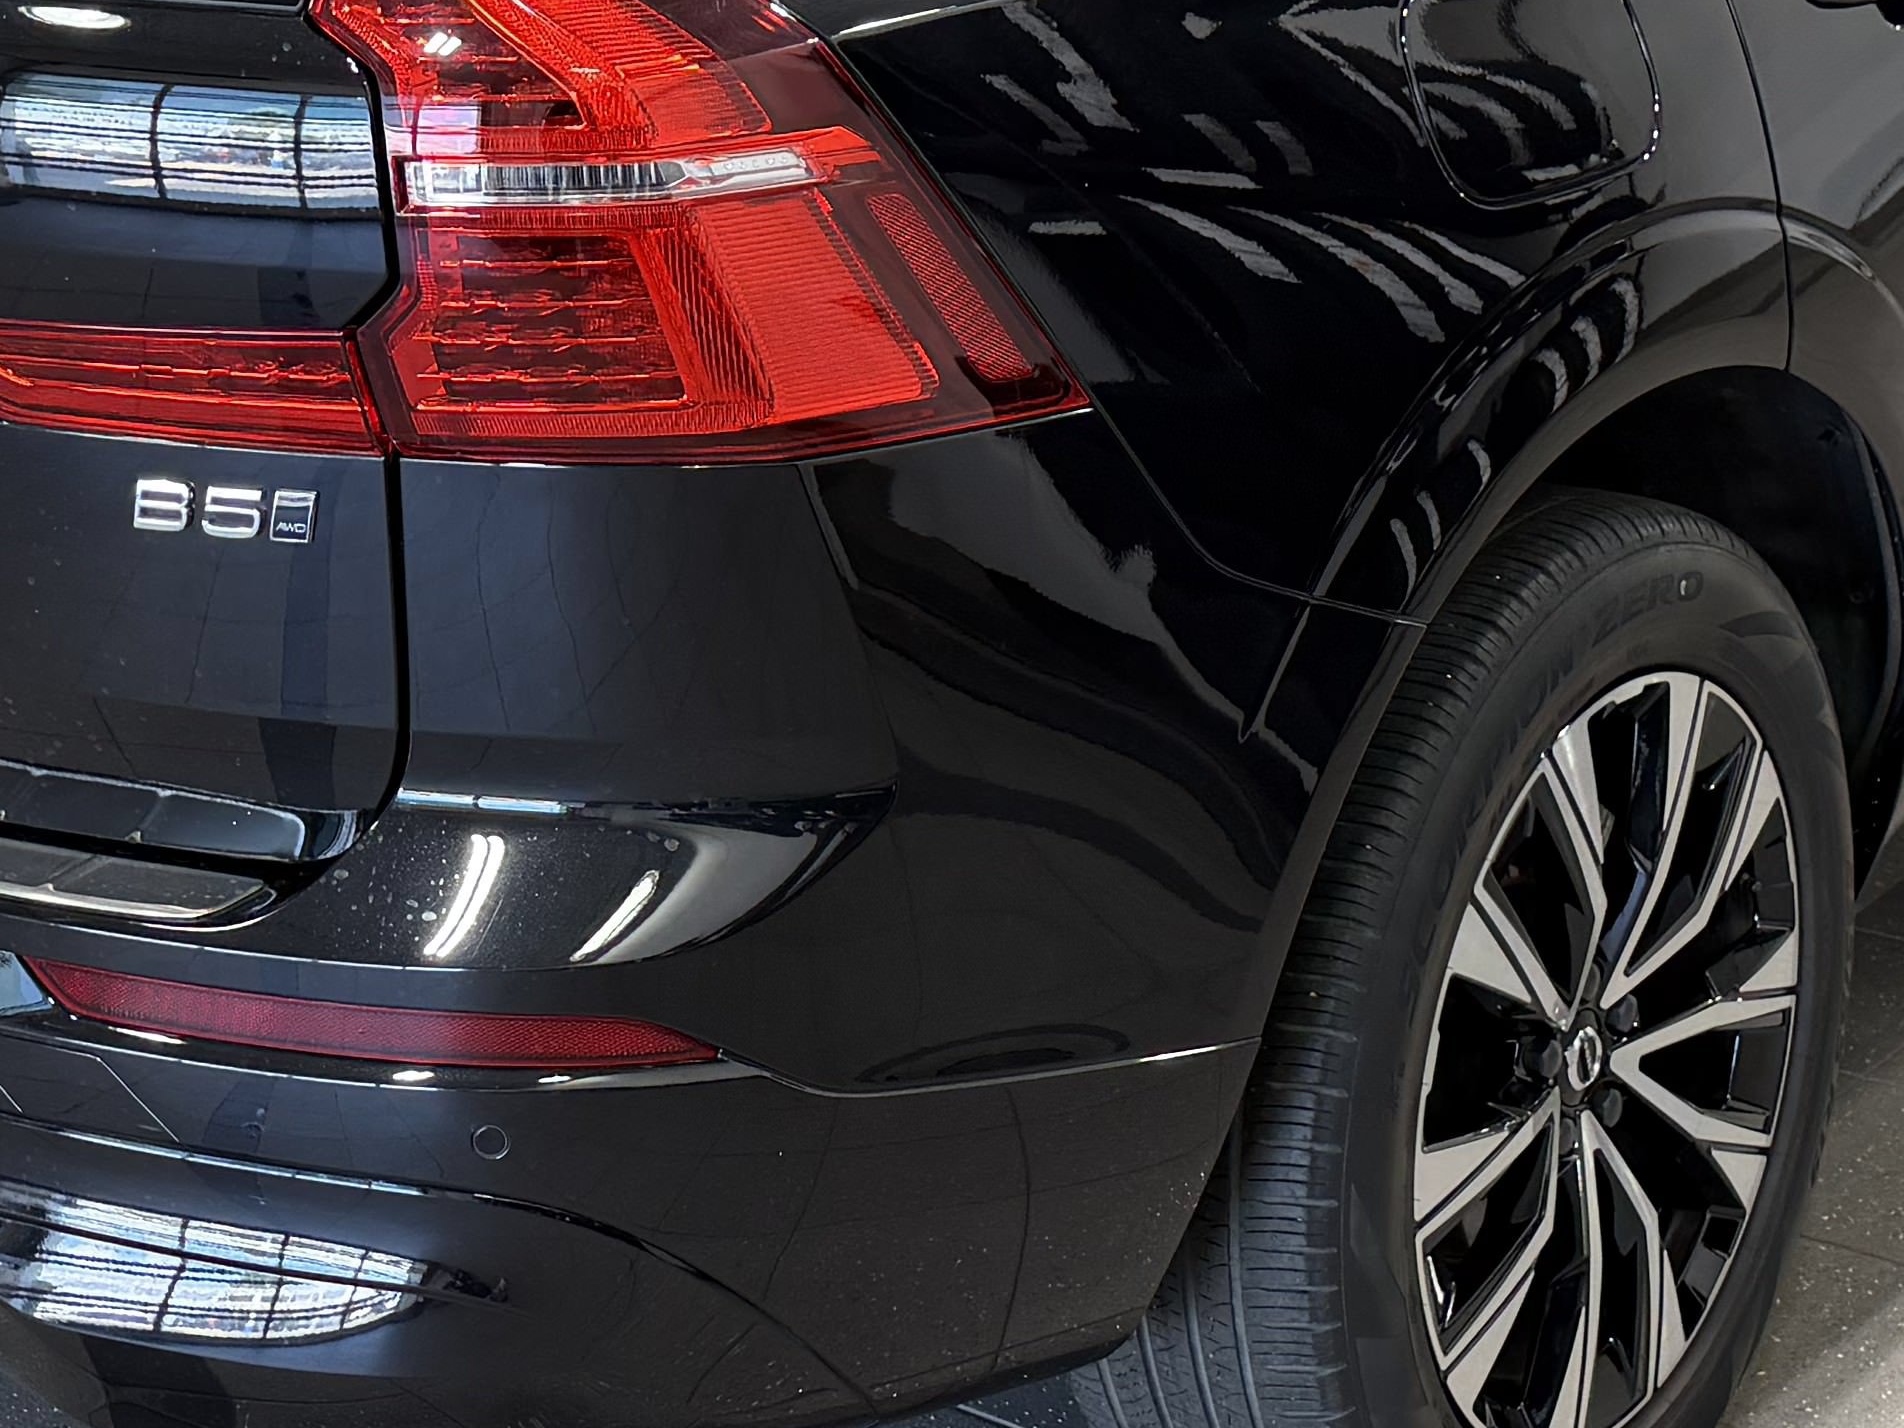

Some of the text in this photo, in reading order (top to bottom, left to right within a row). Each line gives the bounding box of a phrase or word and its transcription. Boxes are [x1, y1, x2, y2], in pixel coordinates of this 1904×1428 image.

[133, 477, 307, 539] B5 AWD
[1593, 569, 1705, 649] ZERO
